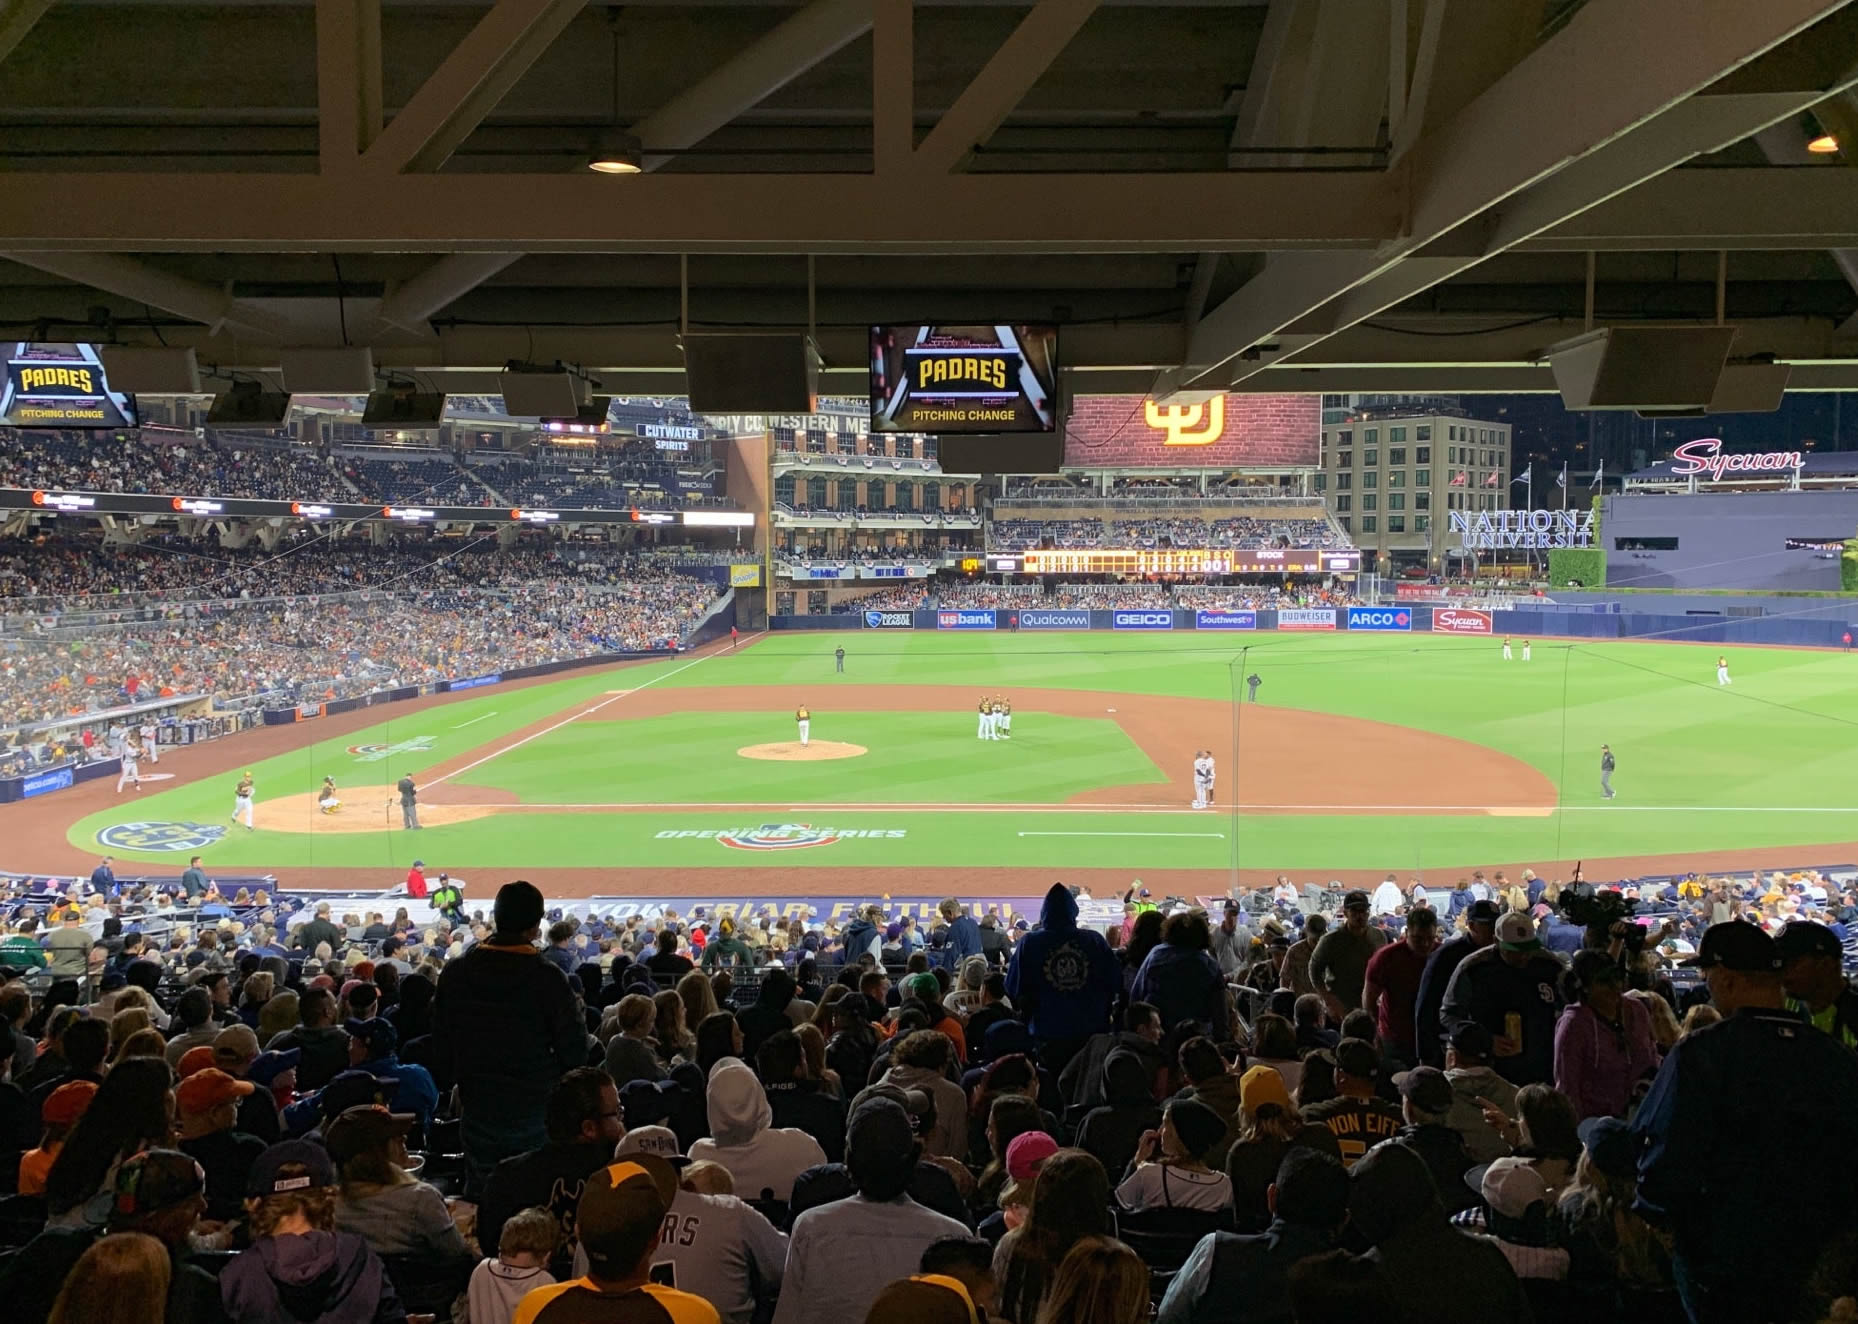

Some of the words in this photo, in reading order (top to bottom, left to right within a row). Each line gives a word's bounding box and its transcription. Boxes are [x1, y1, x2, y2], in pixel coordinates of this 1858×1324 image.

[919, 358, 1006, 389] PADRES
[21, 368, 93, 393] PADRES
[21, 409, 64, 418] PITCHING
[66, 410, 104, 419] CHANGE
[913, 411, 965, 420] PITCHING
[968, 411, 1015, 420] CHANGE
[769, 415, 838, 431] WESTERN
[645, 426, 698, 440] CUTWATER
[655, 441, 688, 450] SPIRITS
[1672, 438, 1806, 481] Sycuan
[1022, 613, 1088, 627] Qualcomm
[1116, 614, 1171, 625] GEICO
[1200, 615, 1246, 624] Southwest
[1282, 612, 1331, 620] BUDWEISER
[1350, 613, 1394, 625] ARCO
[1439, 611, 1485, 629] Sycuan
[654, 829, 793, 839] OPENING
[795, 829, 907, 839] SERIES
[1328, 1113, 1360, 1136] VON
